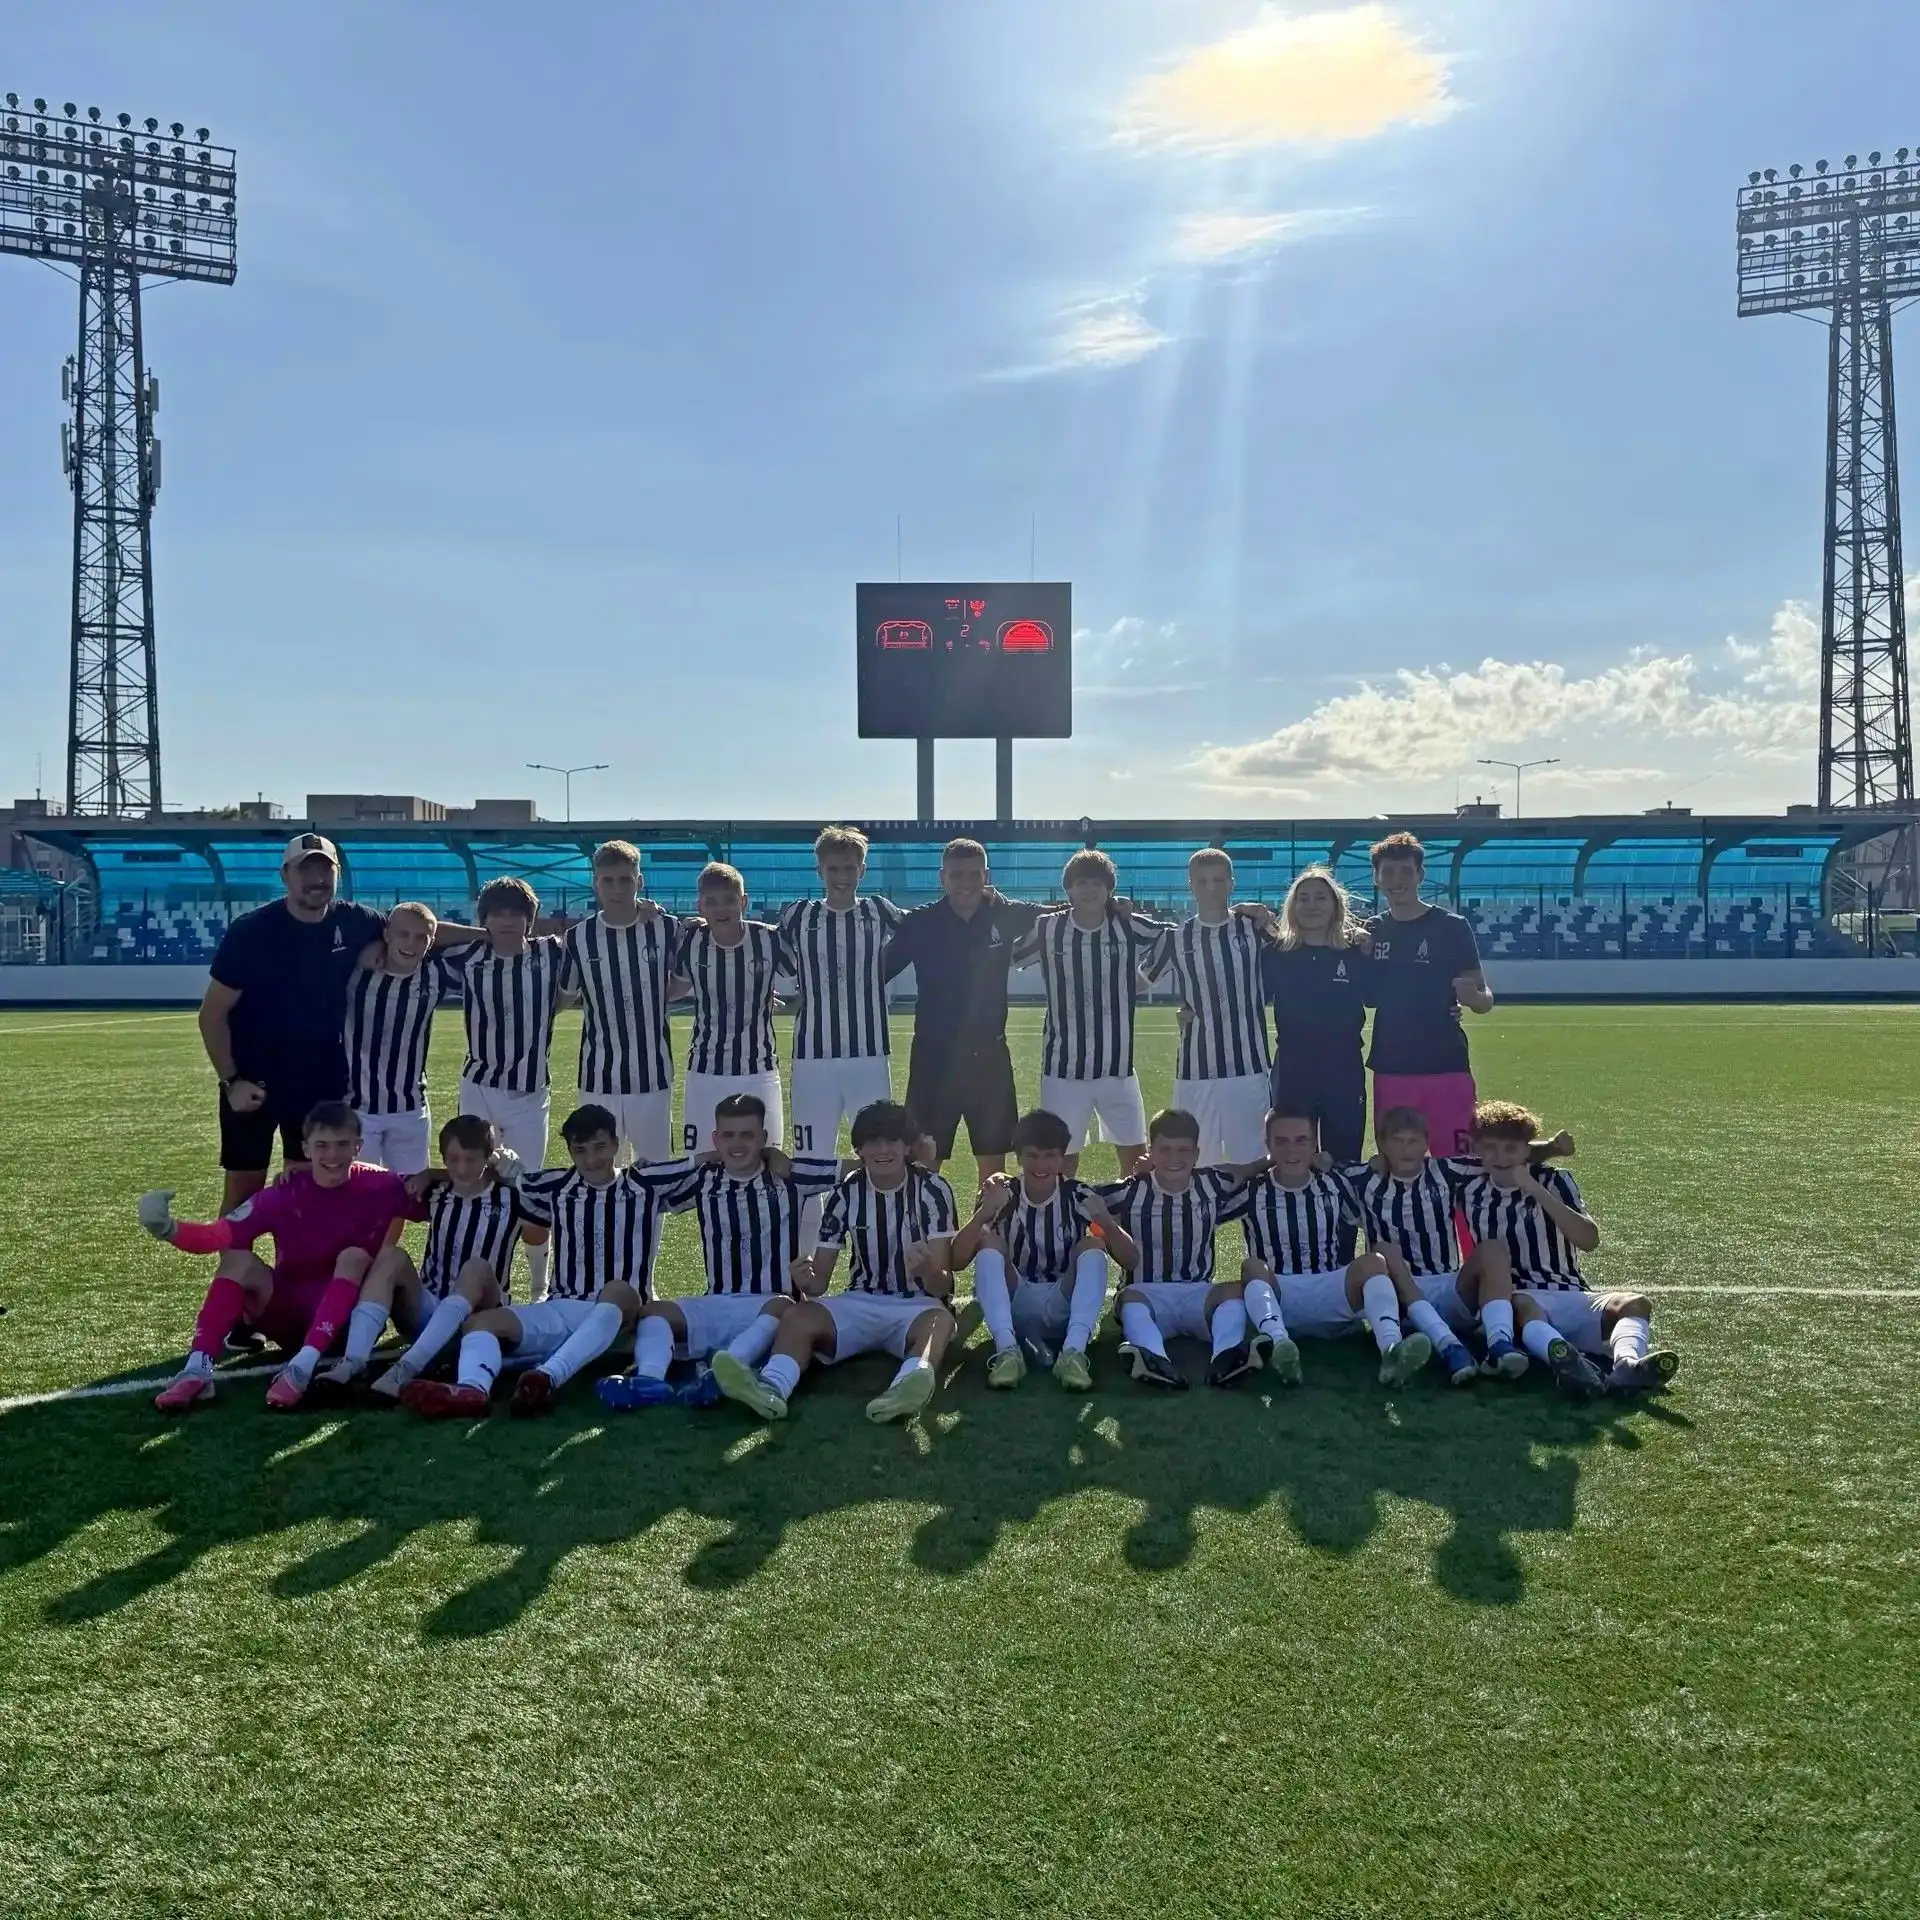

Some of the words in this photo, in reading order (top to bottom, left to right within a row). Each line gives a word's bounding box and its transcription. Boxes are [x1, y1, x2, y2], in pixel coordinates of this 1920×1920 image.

[1374, 941, 1391, 960] 62
[684, 1124, 698, 1150] 8
[795, 1124, 813, 1151] 91
